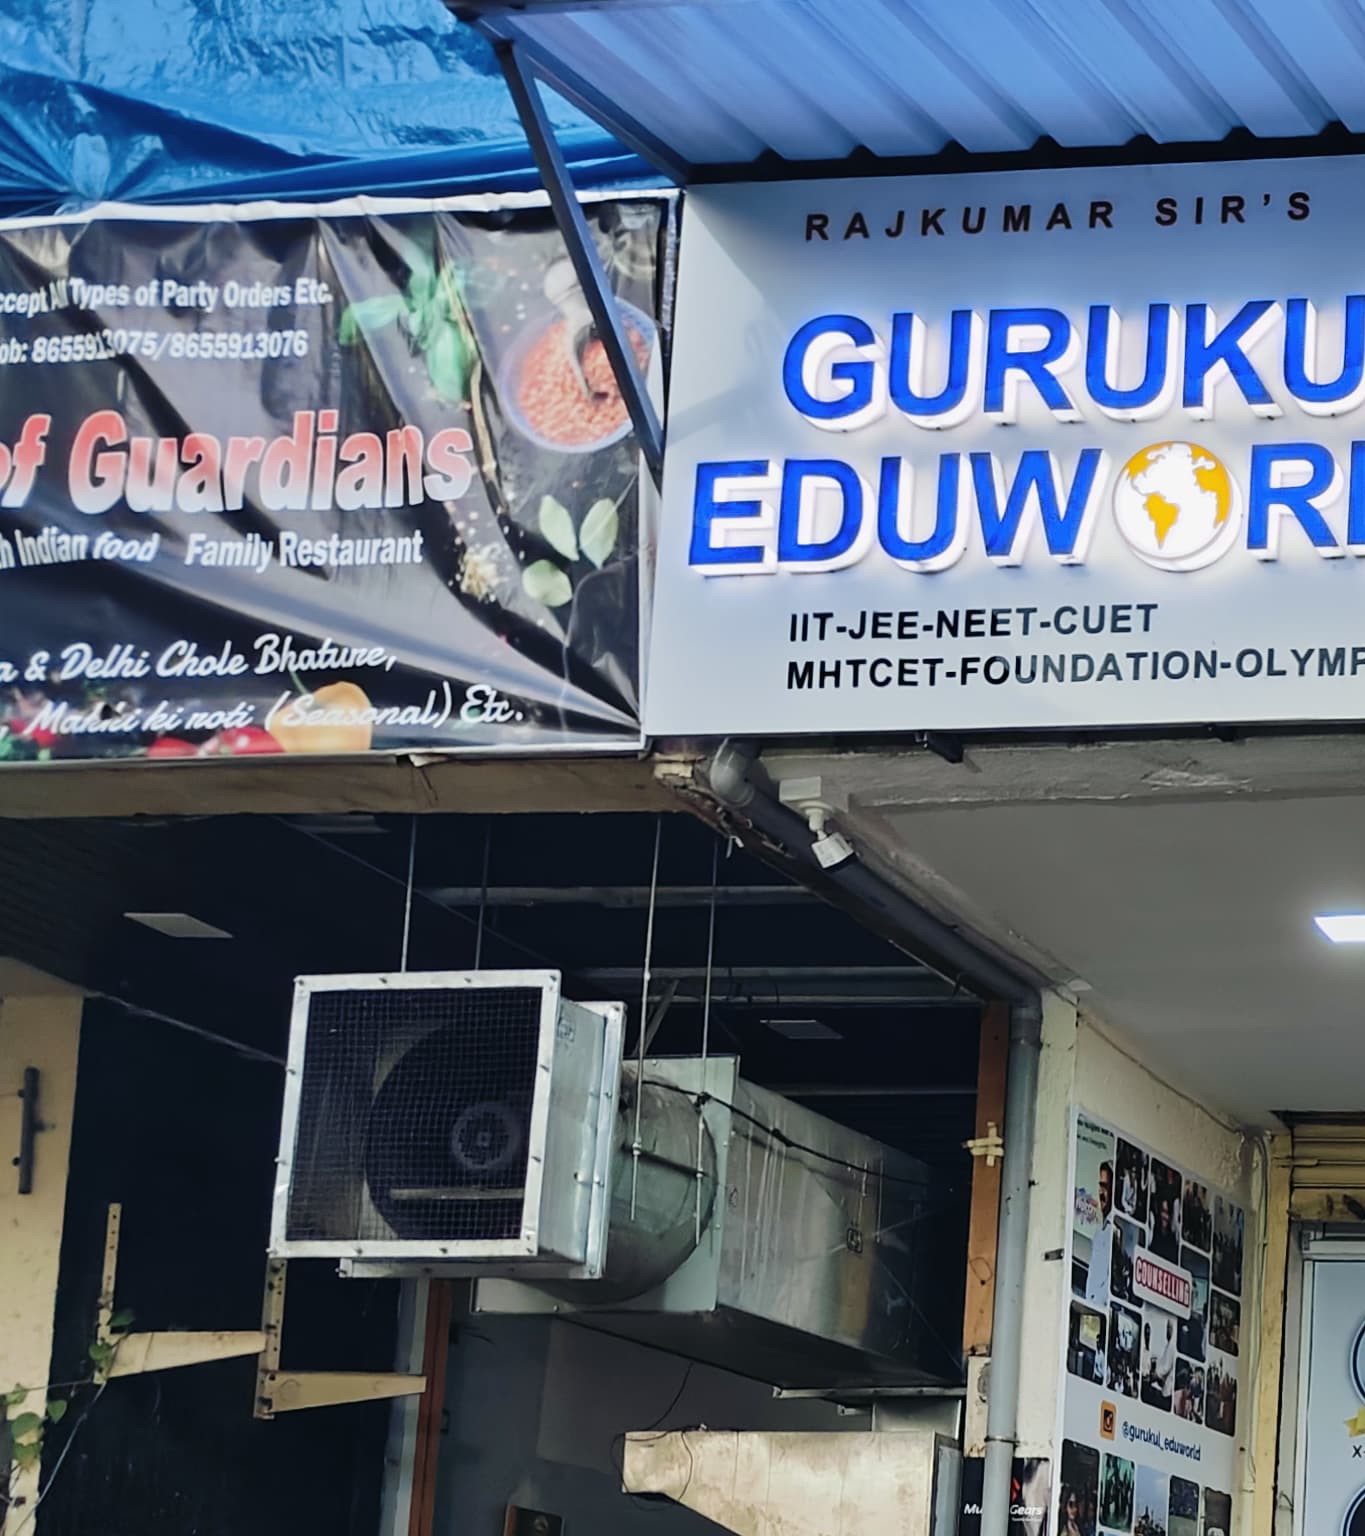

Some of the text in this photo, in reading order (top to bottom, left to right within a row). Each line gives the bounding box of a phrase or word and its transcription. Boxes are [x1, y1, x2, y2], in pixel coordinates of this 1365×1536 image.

[804, 191, 1314, 243] RAJKUMAR SIR'S
[70, 277, 129, 311] Types
[135, 280, 159, 307] of
[162, 280, 219, 313] Party
[223, 279, 292, 308] Orders
[295, 276, 334, 305] Etc.
[31, 329, 309, 363] 8655913075/8655913076
[68, 408, 475, 516] Guardians
[16, 526, 87, 568] Indian
[92, 530, 161, 563] food
[184, 532, 274, 574] Family
[279, 529, 424, 567] Restaurant
[788, 602, 1158, 644] IIT-JEE-NEET-CUET
[24, 651, 47, 683] &
[60, 641, 151, 682] Delhi
[156, 640, 249, 677] Chole
[253, 632, 398, 675] Bhature,
[264, 680, 453, 731] (Seasonal)
[461, 684, 524, 725] Etc.
[1010, 1503, 1043, 1516] Gears
